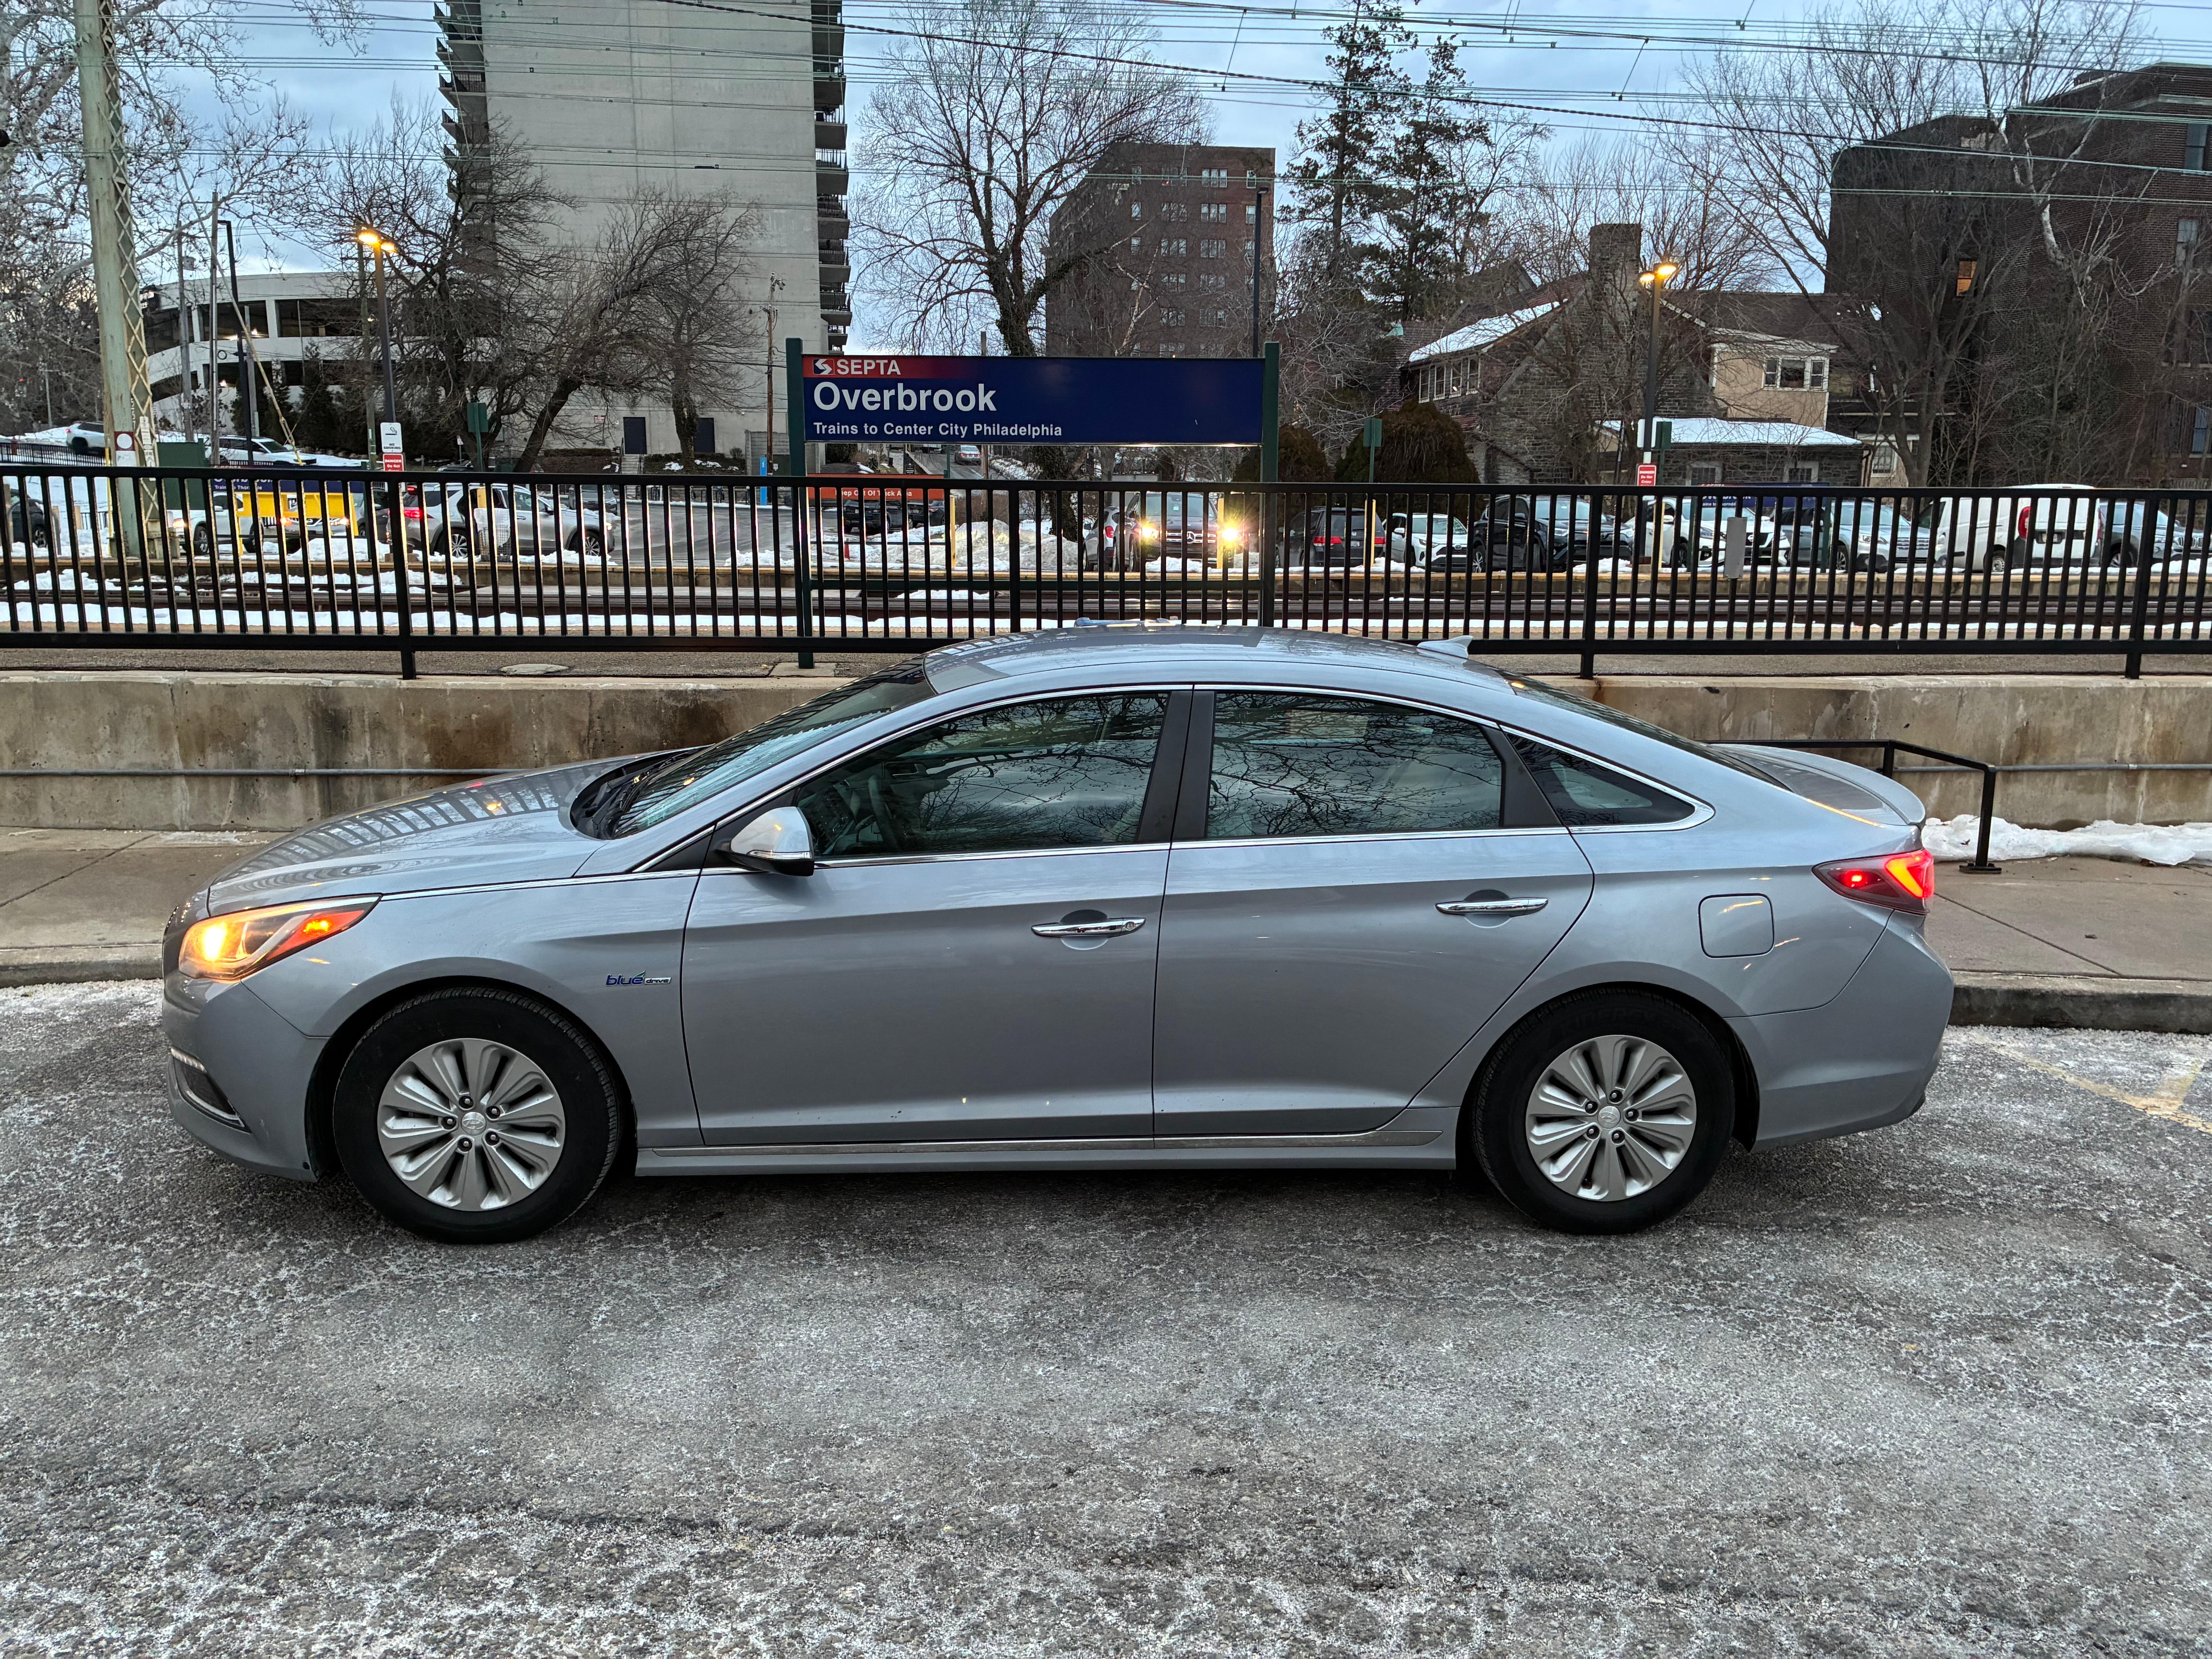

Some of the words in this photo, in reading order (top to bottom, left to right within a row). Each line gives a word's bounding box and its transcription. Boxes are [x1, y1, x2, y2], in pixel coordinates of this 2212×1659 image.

[836, 359, 901, 375] SEPTA
[814, 381, 997, 411] Overbrook
[813, 422, 858, 434] Trains
[864, 423, 878, 434] to
[884, 423, 933, 434] Center
[939, 423, 968, 438] City
[974, 424, 1062, 438] Philadelphia
[605, 974, 644, 986] blue
